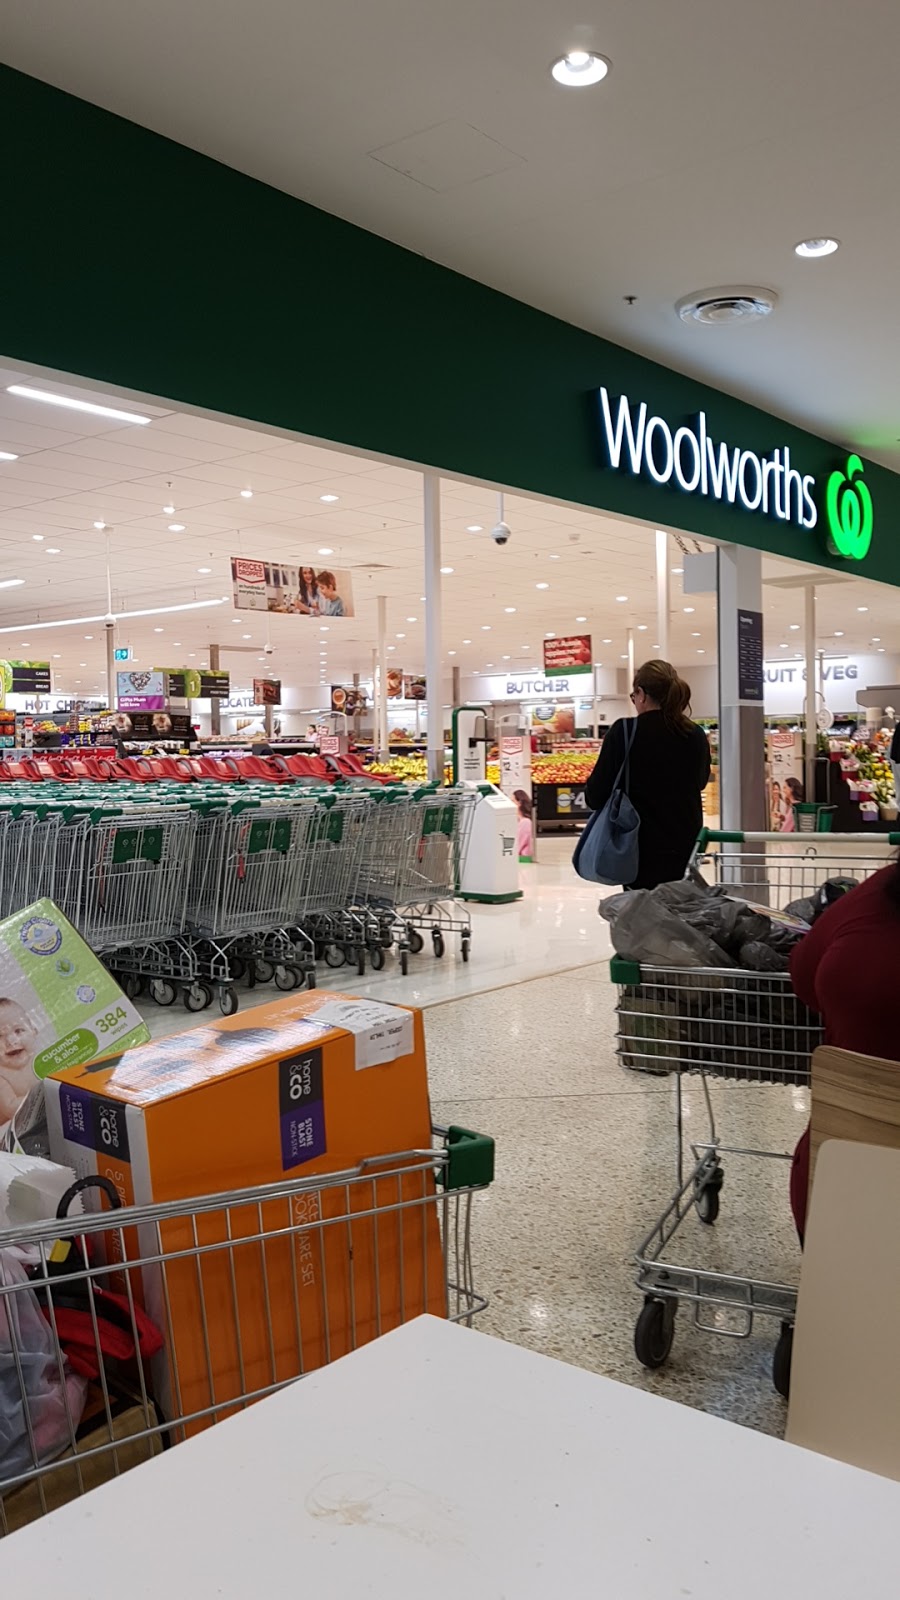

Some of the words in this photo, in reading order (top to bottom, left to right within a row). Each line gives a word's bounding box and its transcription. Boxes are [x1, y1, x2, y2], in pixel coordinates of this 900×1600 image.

[600, 386, 818, 529] Woolworths
[238, 561, 263, 572] PRICES
[506, 679, 570, 694] BUTCHER
[762, 668, 797, 683] RUIT
[821, 664, 858, 681] VEG
[25, 700, 50, 711] HOT
[95, 1006, 127, 1033] 384
[110, 1022, 128, 1035] wipes
[42, 1033, 80, 1062] cucumber
[54, 1056, 61, 1064] &
[62, 1045, 79, 1059] aloe
[289, 1064, 303, 1100] &CO
[303, 1058, 313, 1095] home
[71, 1101, 80, 1129] BLAST
[77, 1101, 85, 1132] STONE
[99, 1105, 112, 1145] &CO
[109, 1109, 119, 1148] home
[290, 1120, 298, 1157] NON-STICK
[298, 1122, 306, 1148] BLAST
[305, 1117, 314, 1147] STONE
[115, 1171, 124, 1181] 5
[307, 1192, 319, 1222] IECE
[294, 1193, 313, 1263] OOKARE
[301, 1262, 315, 1287] SET
